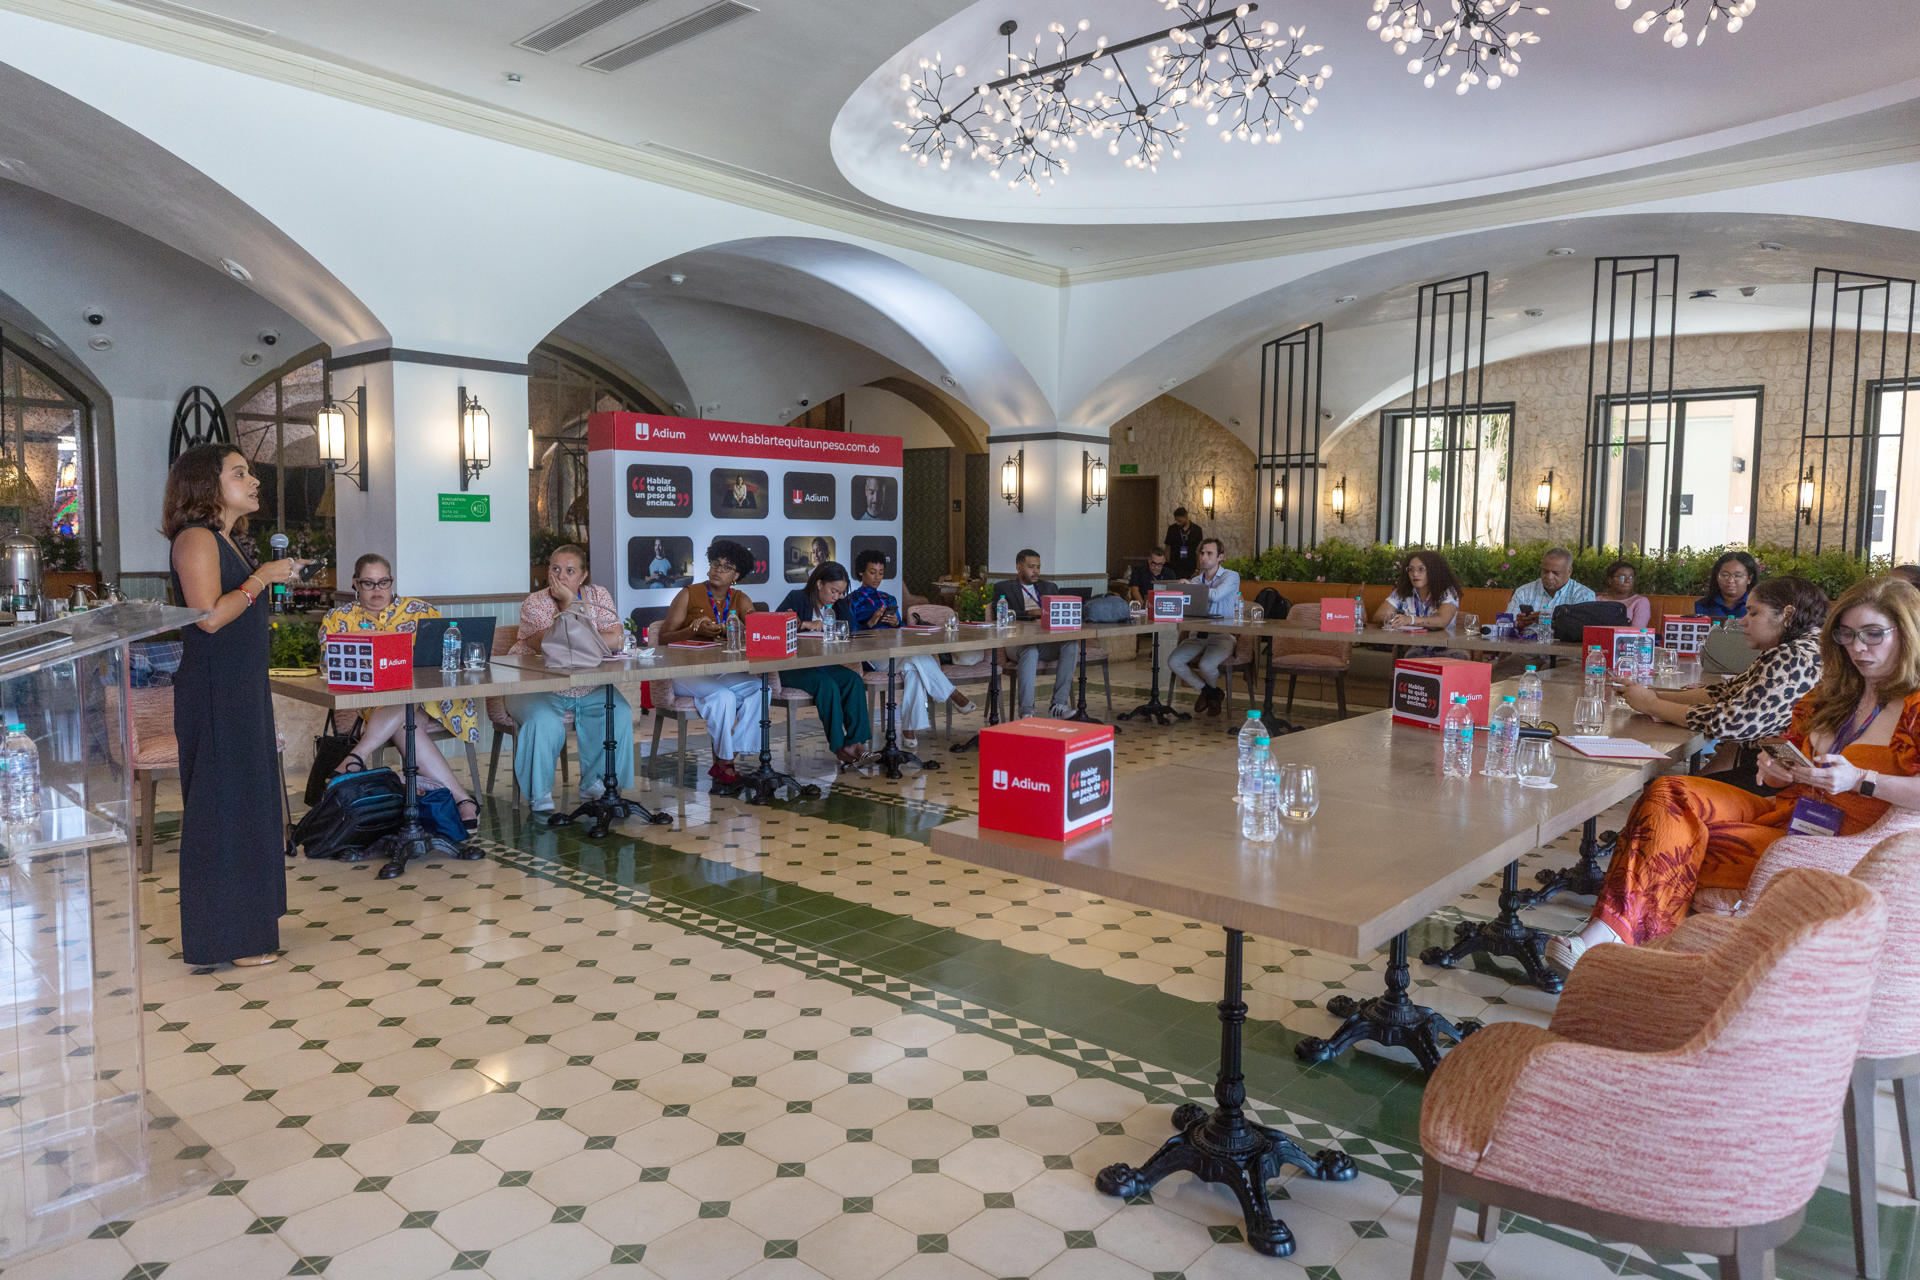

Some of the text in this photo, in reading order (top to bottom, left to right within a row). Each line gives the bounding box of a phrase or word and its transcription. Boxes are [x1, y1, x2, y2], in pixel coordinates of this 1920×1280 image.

[652, 428, 686, 440] Adium
[709, 431, 880, 454] www.hablartequitaunpeso.com.do
[645, 499, 676, 507] encima.
[804, 494, 829, 502] Adium
[1011, 777, 1050, 792] Adium
